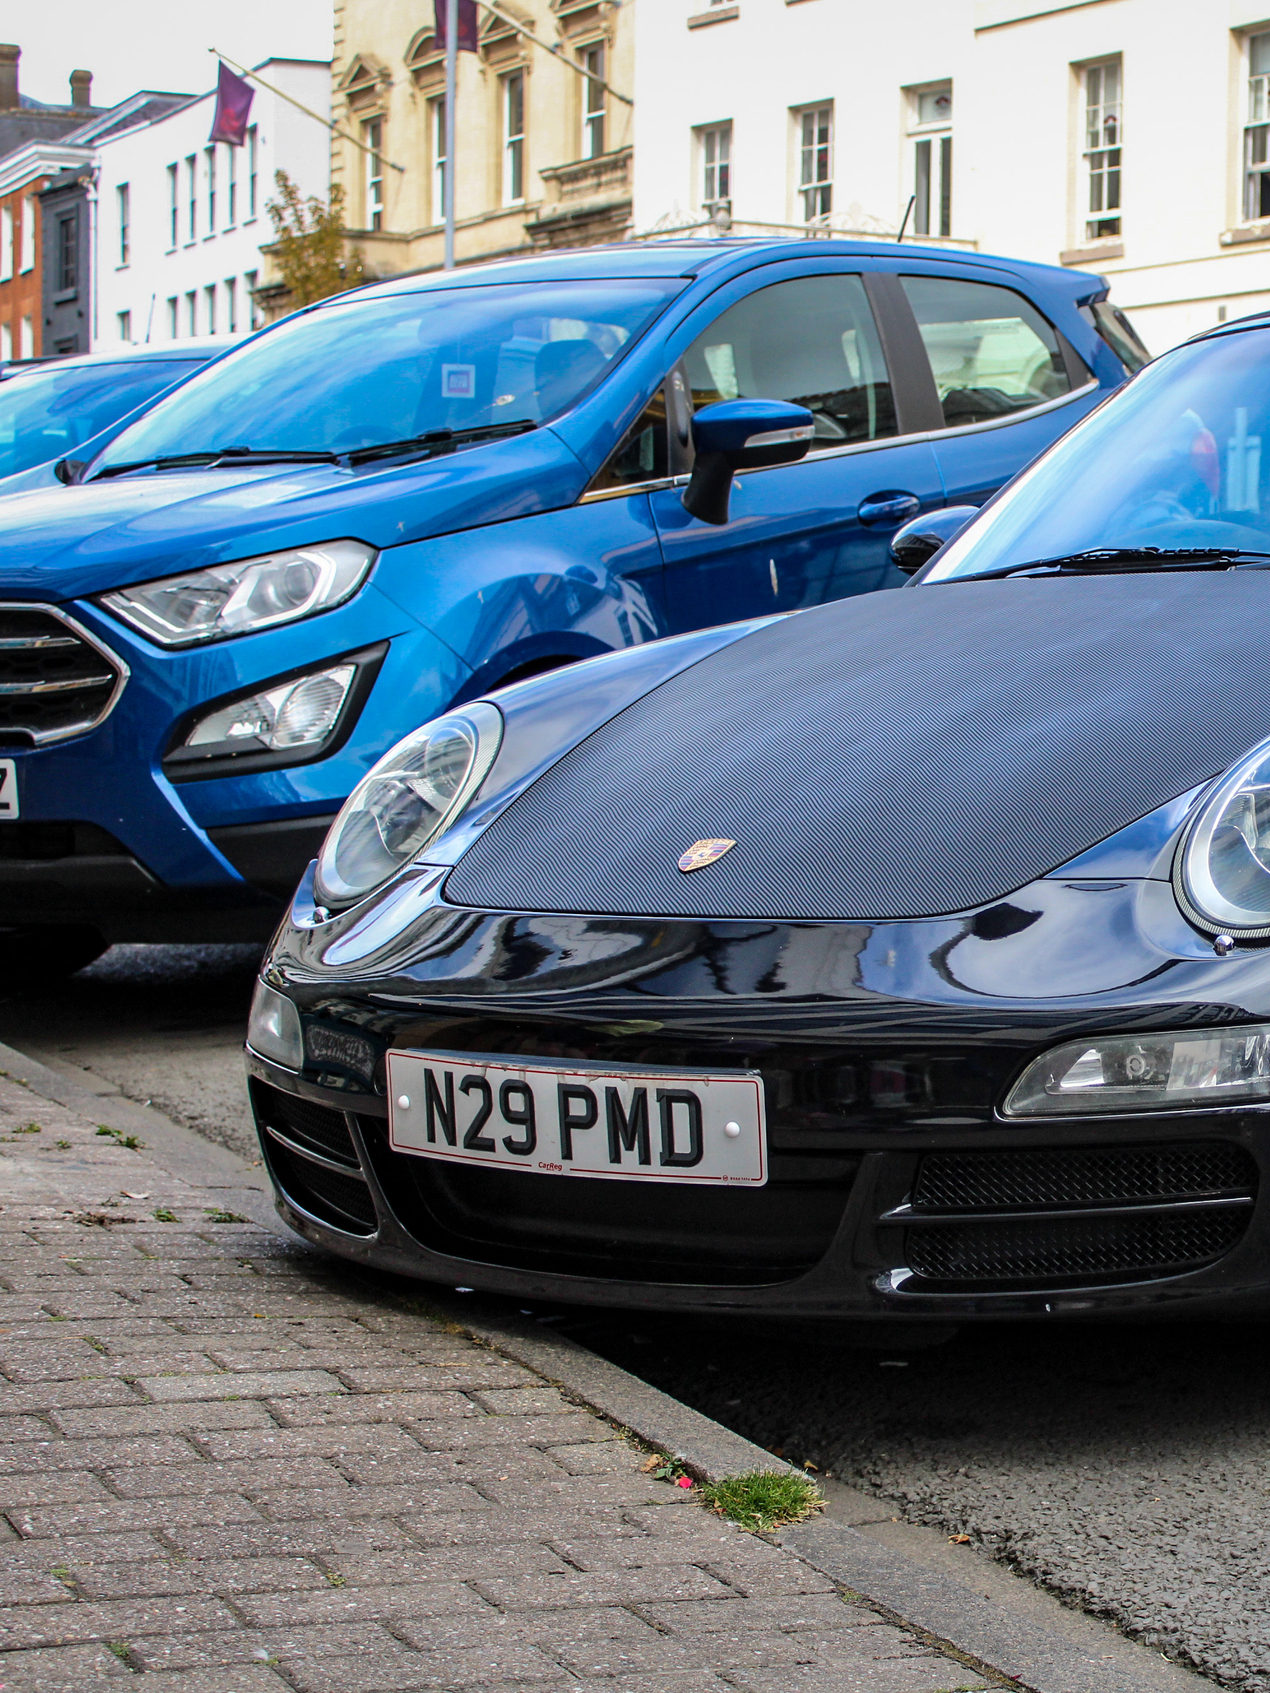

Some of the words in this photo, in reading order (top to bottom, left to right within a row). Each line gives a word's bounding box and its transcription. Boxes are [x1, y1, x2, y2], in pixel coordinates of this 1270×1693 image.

[423, 1067, 537, 1156] N29
[557, 1082, 704, 1168] PMD
[538, 1161, 562, 1171] CarReg
